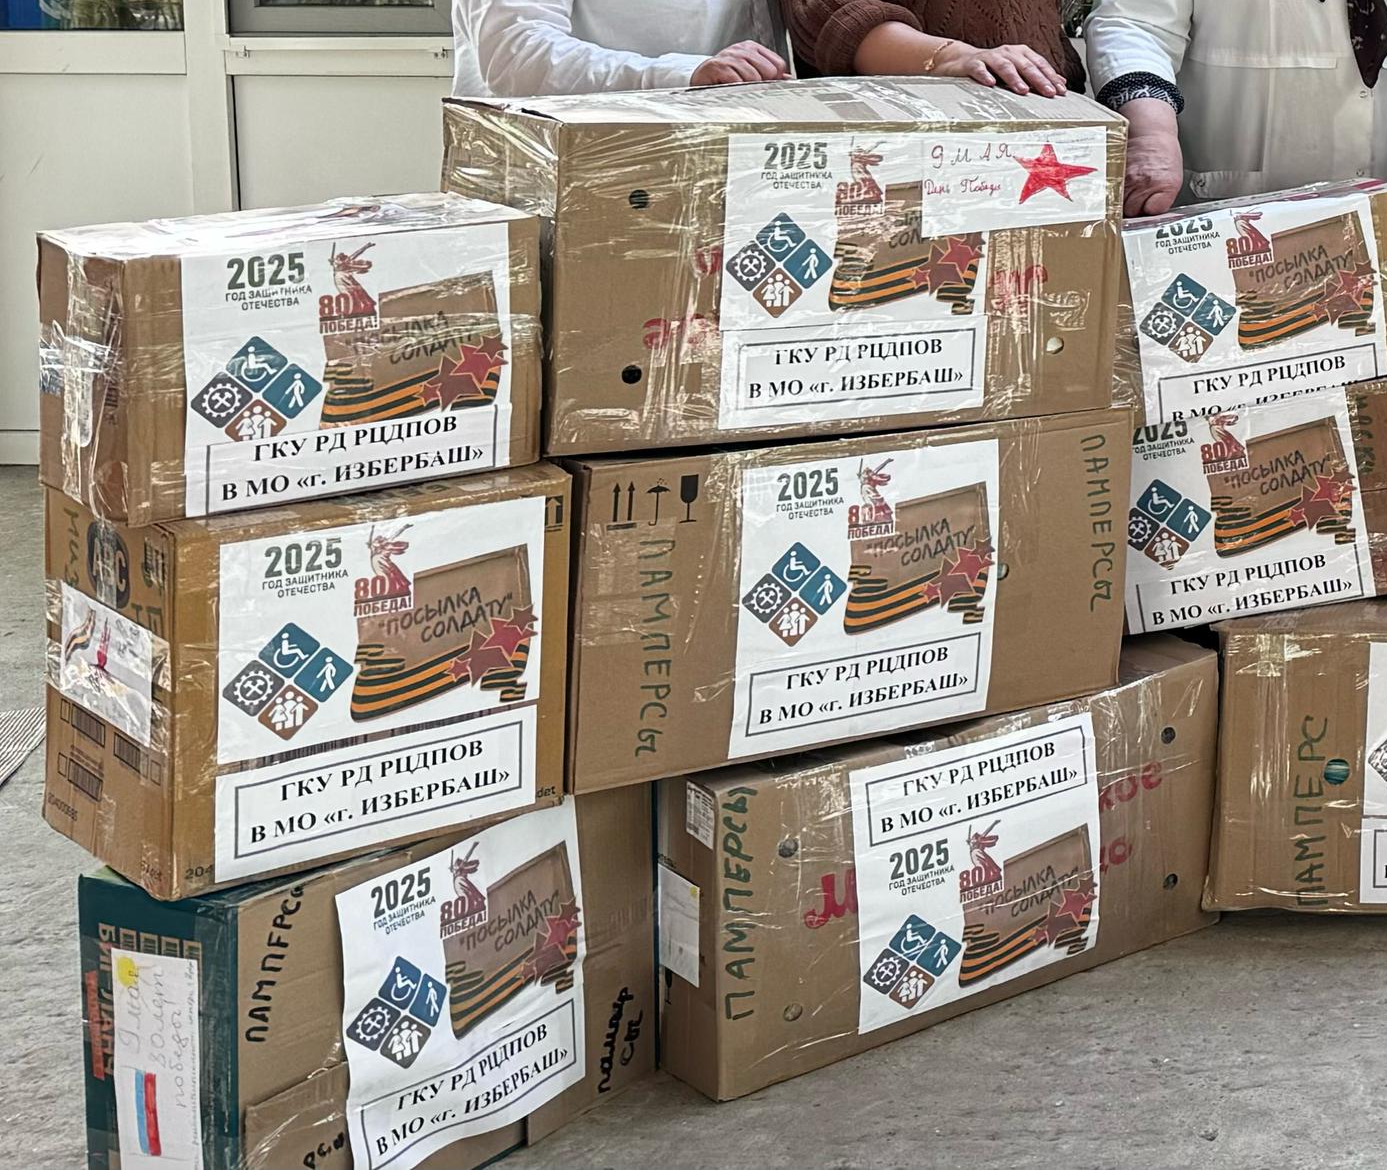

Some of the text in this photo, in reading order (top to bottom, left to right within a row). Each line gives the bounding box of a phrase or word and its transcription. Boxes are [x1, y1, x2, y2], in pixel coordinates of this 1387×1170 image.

[226, 252, 306, 291] 2025
[222, 445, 484, 501] В МО «г. ИЗБЕРБАШ»
[778, 467, 840, 503] 2025
[265, 536, 343, 579] 2025
[262, 569, 349, 591] ГОД ЗАЩИТНИКА
[277, 582, 336, 599] ОТЕЧЕСТВА
[354, 573, 388, 603] 80
[1152, 578, 1353, 626] В МО «г. ИЗБЕРБАШ»
[281, 740, 483, 802] ГКУ РД РЦДПОВ
[903, 743, 1055, 798] ГКУ РД РЦДПОВ
[251, 825, 266, 842] В
[274, 813, 317, 837] МО
[324, 808, 354, 825] «г.
[362, 768, 511, 817] ИЗБЕРБАШ»
